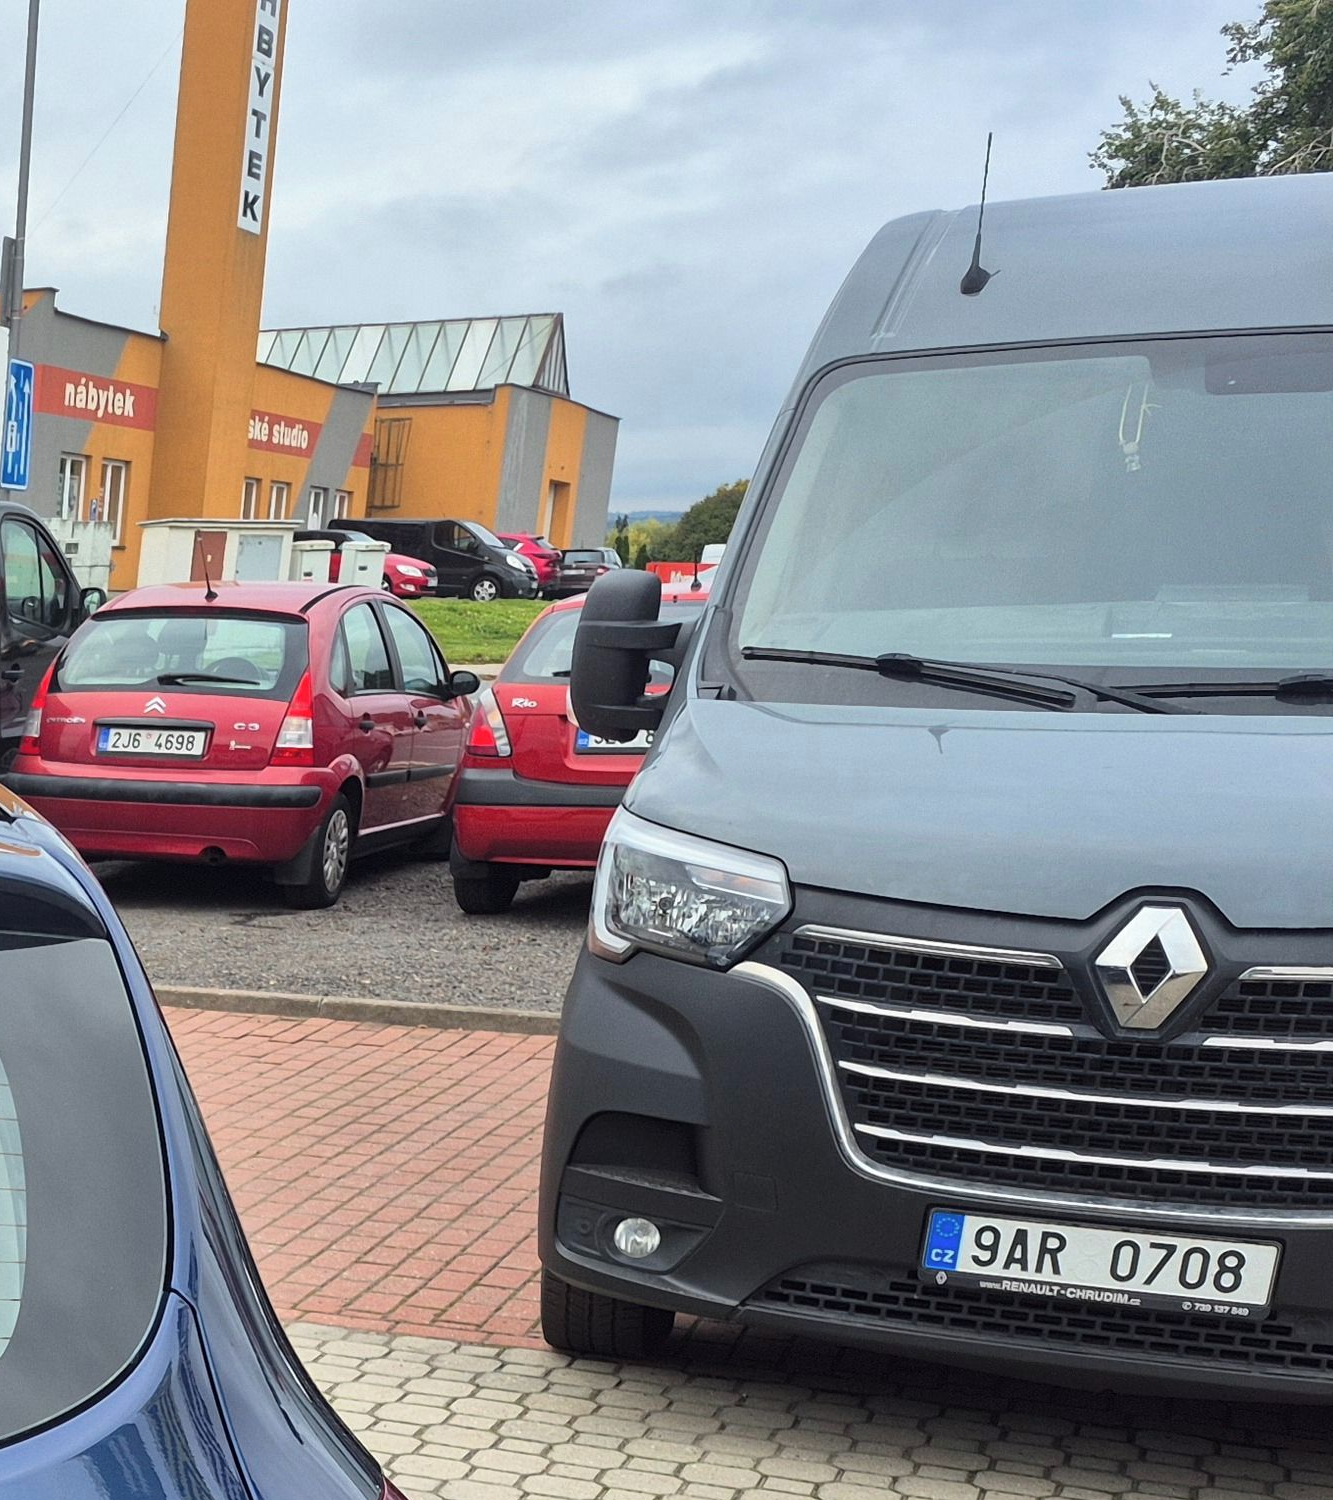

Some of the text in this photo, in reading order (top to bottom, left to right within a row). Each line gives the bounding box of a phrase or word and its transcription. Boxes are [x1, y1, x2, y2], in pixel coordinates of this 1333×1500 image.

[64, 377, 135, 418] nábytek
[272, 420, 309, 450] studio
[511, 697, 538, 708] Rio
[111, 731, 196, 752] 2J6 4698
[930, 1248, 955, 1264] CZ
[971, 1224, 1247, 1294] 9AR 0708
